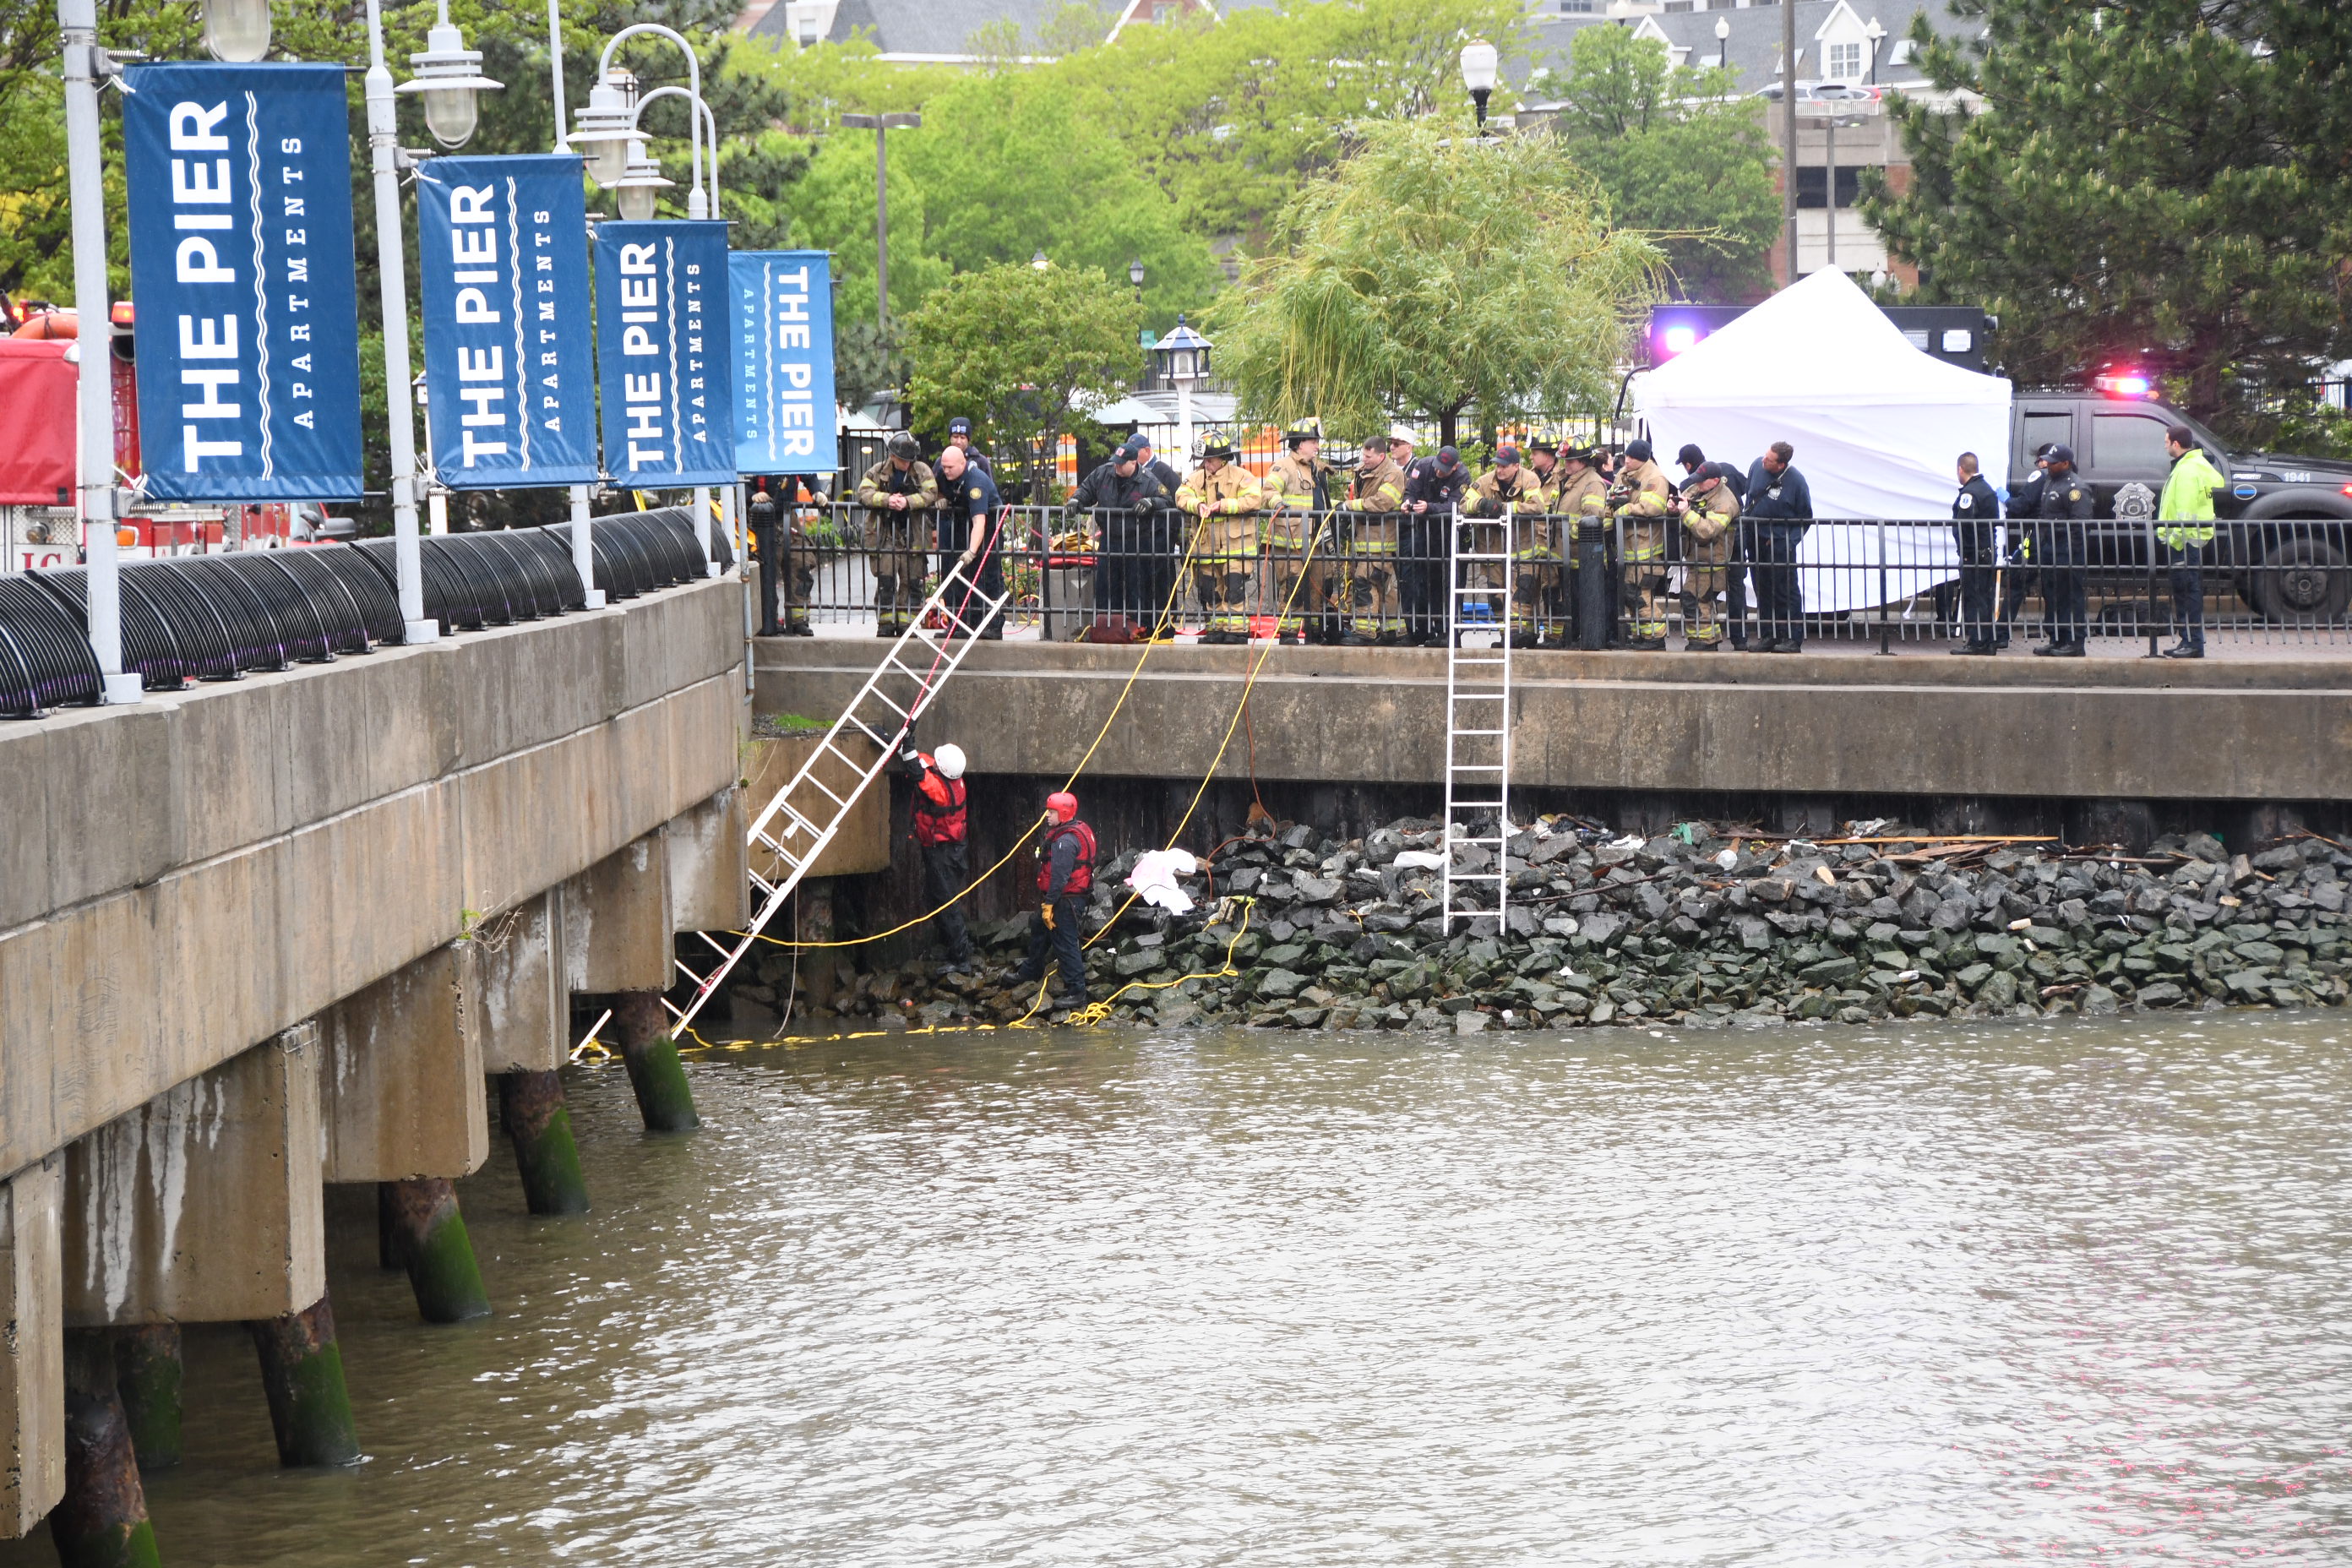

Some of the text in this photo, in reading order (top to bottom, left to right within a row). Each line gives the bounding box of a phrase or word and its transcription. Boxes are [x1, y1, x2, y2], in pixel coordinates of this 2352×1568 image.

[170, 100, 242, 473] THE PIER
[281, 138, 314, 430] APARTMENTS
[449, 183, 509, 468] THE PIER
[533, 210, 561, 433] APARTMENTS
[619, 242, 665, 472] THE PIER
[686, 264, 707, 444] APARTMENTS
[743, 288, 758, 439] APARTMENTS
[778, 266, 815, 457] THE PIER
[2284, 472, 2311, 482] 1941
